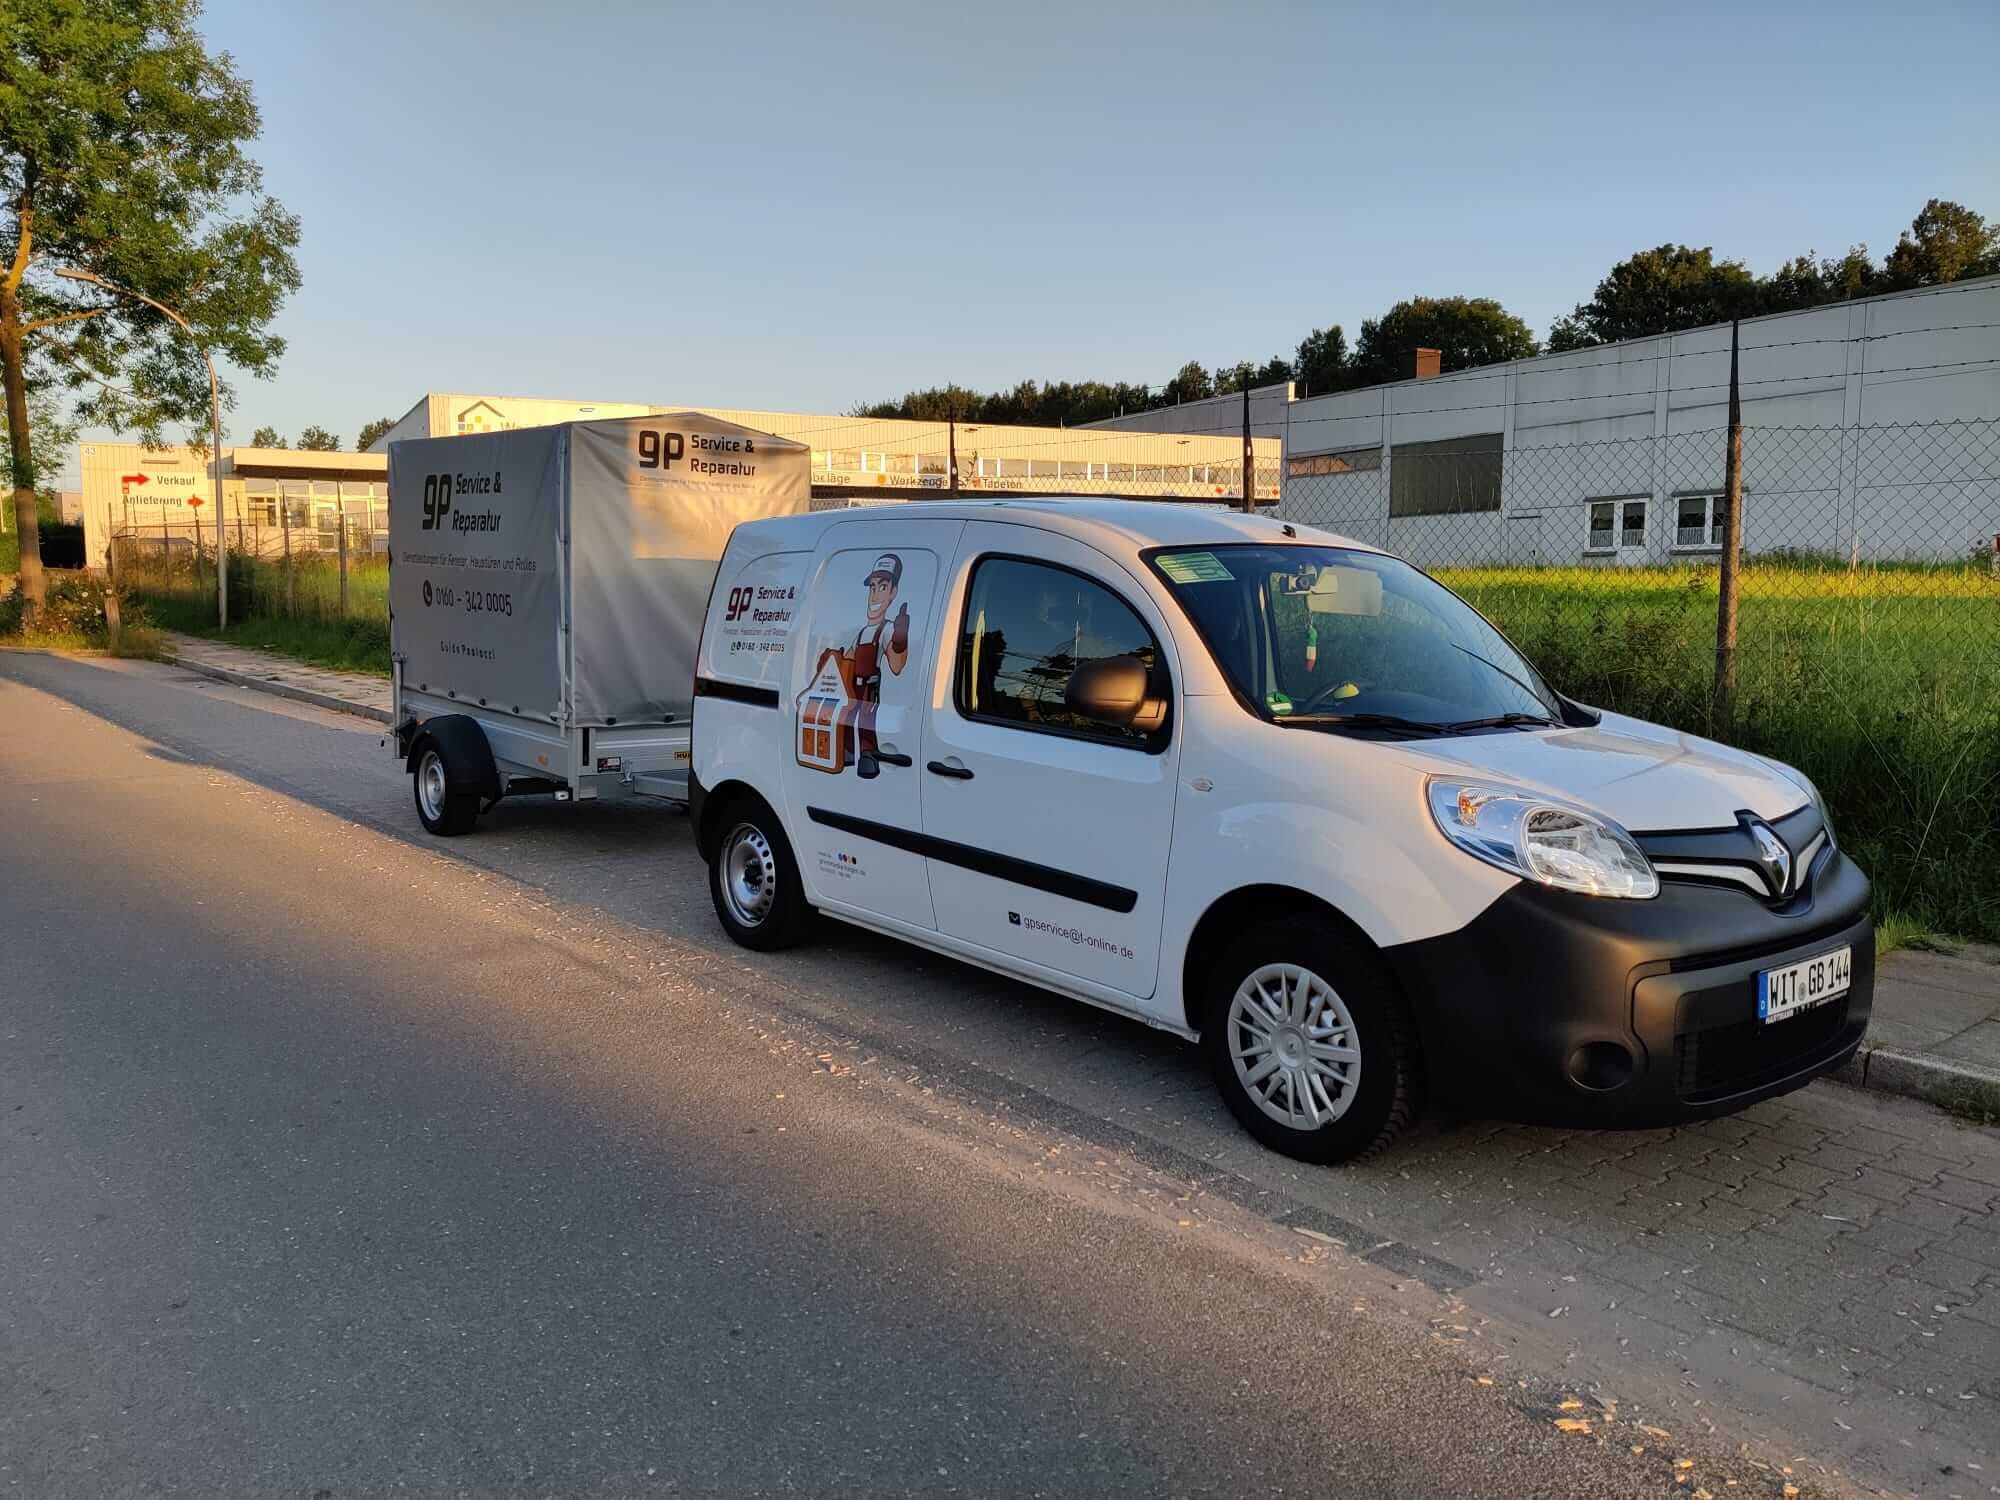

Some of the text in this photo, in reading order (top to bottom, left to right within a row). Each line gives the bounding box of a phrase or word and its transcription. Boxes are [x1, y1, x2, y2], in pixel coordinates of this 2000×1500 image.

[639, 430, 684, 470] gp
[691, 434, 755, 453] Service &
[690, 458, 756, 476] Reparatur
[157, 475, 196, 486] Verkauf
[455, 471, 502, 495] Service &
[122, 495, 182, 508] Anlieferung
[422, 474, 452, 530] gp
[452, 508, 501, 536] Reparatur
[465, 590, 483, 613] 342
[486, 592, 513, 617] 0005
[726, 587, 754, 621] gp
[757, 585, 795, 600] Service &
[752, 607, 791, 625] Reparatur
[1023, 917, 1134, 960] gpservice@t-online.de
[1770, 970, 1798, 1009] WIT
[1808, 962, 1825, 996] GB
[1828, 952, 1849, 990] 144
